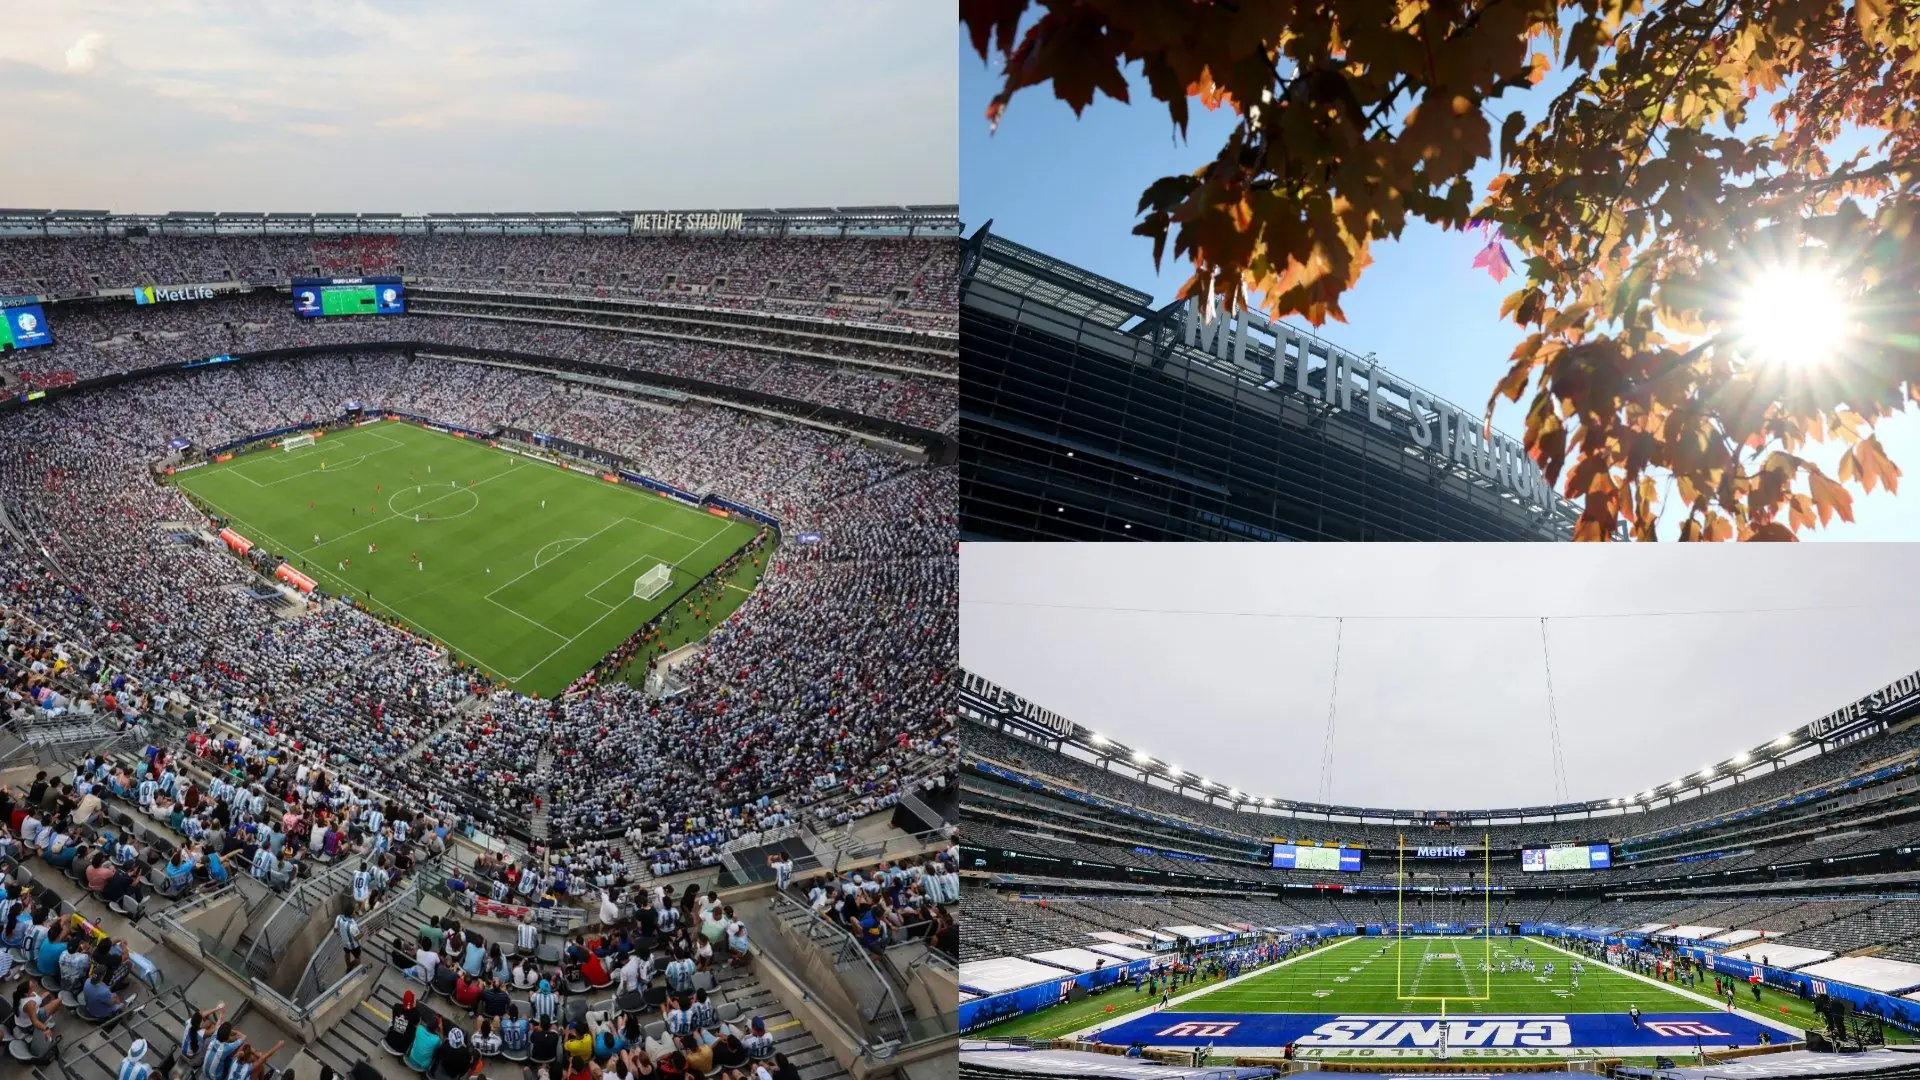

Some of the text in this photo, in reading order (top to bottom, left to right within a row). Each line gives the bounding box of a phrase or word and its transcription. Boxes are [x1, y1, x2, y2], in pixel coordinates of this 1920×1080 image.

[633, 212, 743, 230] METLIFE STADIUM
[155, 286, 213, 302] MetLife
[1185, 294, 1557, 513] METLIFE STADIUM
[1808, 667, 1920, 739] METLIFE STADI
[1012, 695, 1075, 737] STADIUM
[141, 785, 150, 796] 10
[1417, 846, 1466, 857] MetLife
[355, 877, 364, 889] 10
[1294, 1021, 1572, 1046] GIANTS
[1337, 1048, 1375, 1057] OF
[1462, 1048, 1560, 1057] TAKES
